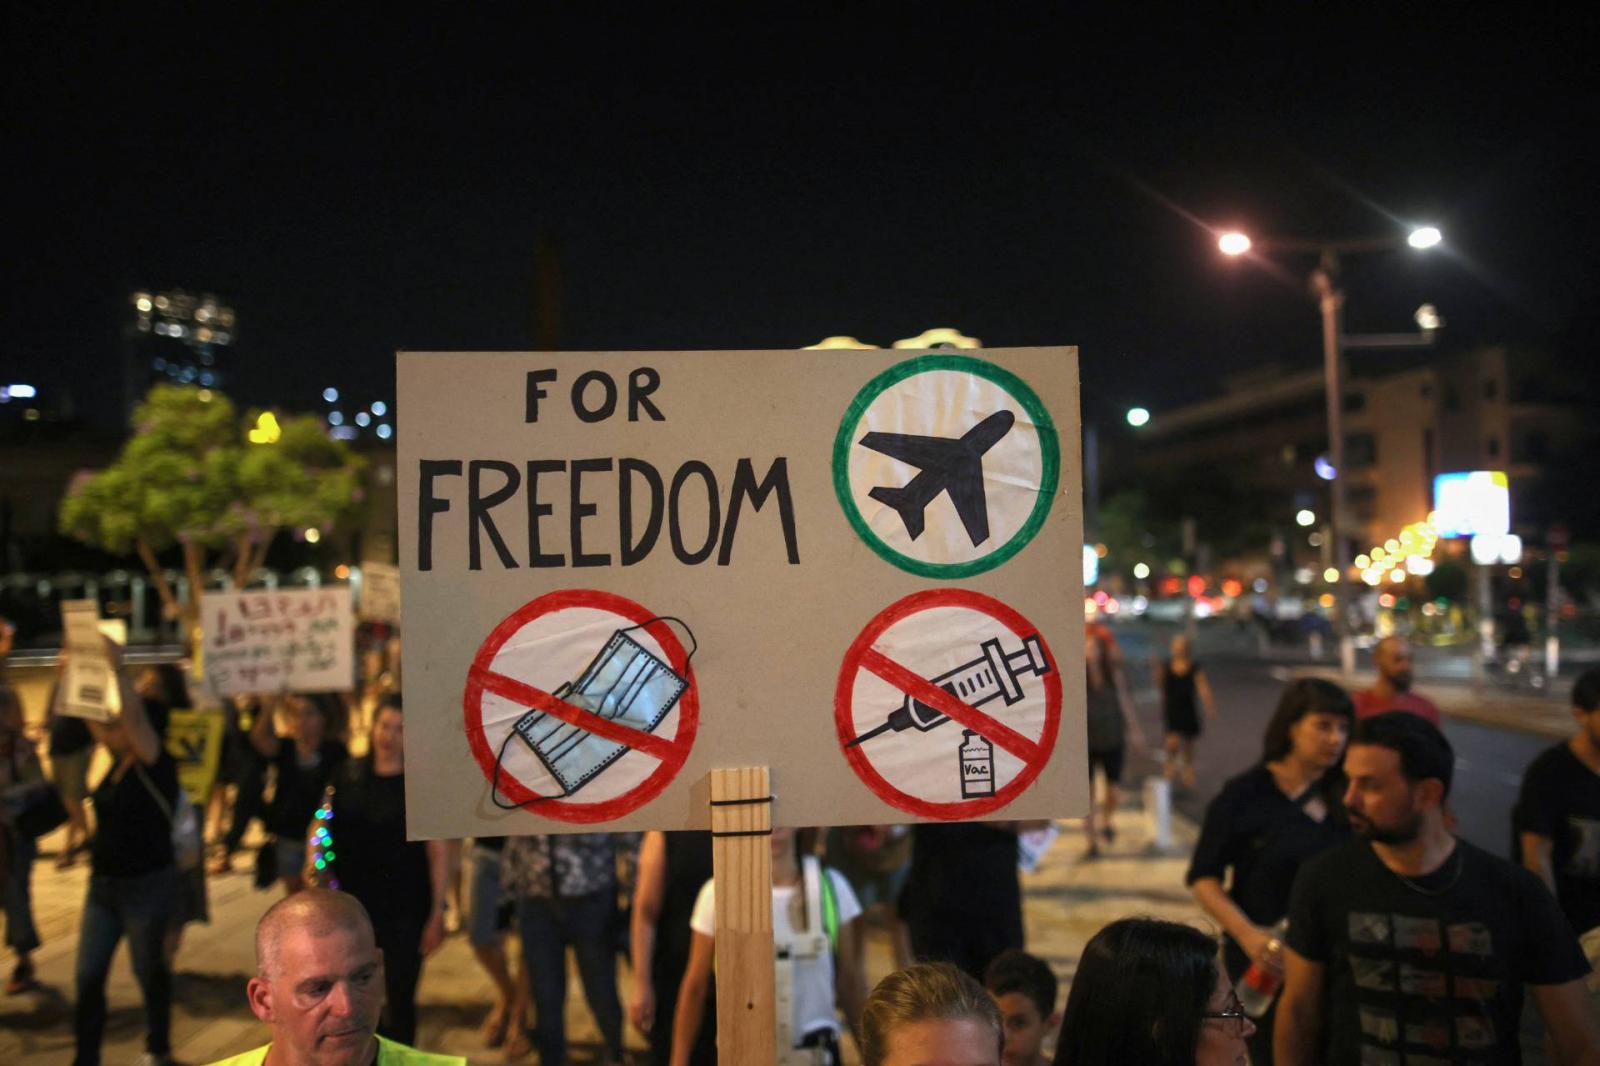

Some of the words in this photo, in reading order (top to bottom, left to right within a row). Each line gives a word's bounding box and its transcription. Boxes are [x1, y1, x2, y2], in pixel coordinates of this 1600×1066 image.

[524, 366, 666, 424] FOR
[417, 456, 801, 572] FREEDOM
[964, 764, 989, 775] Vac
